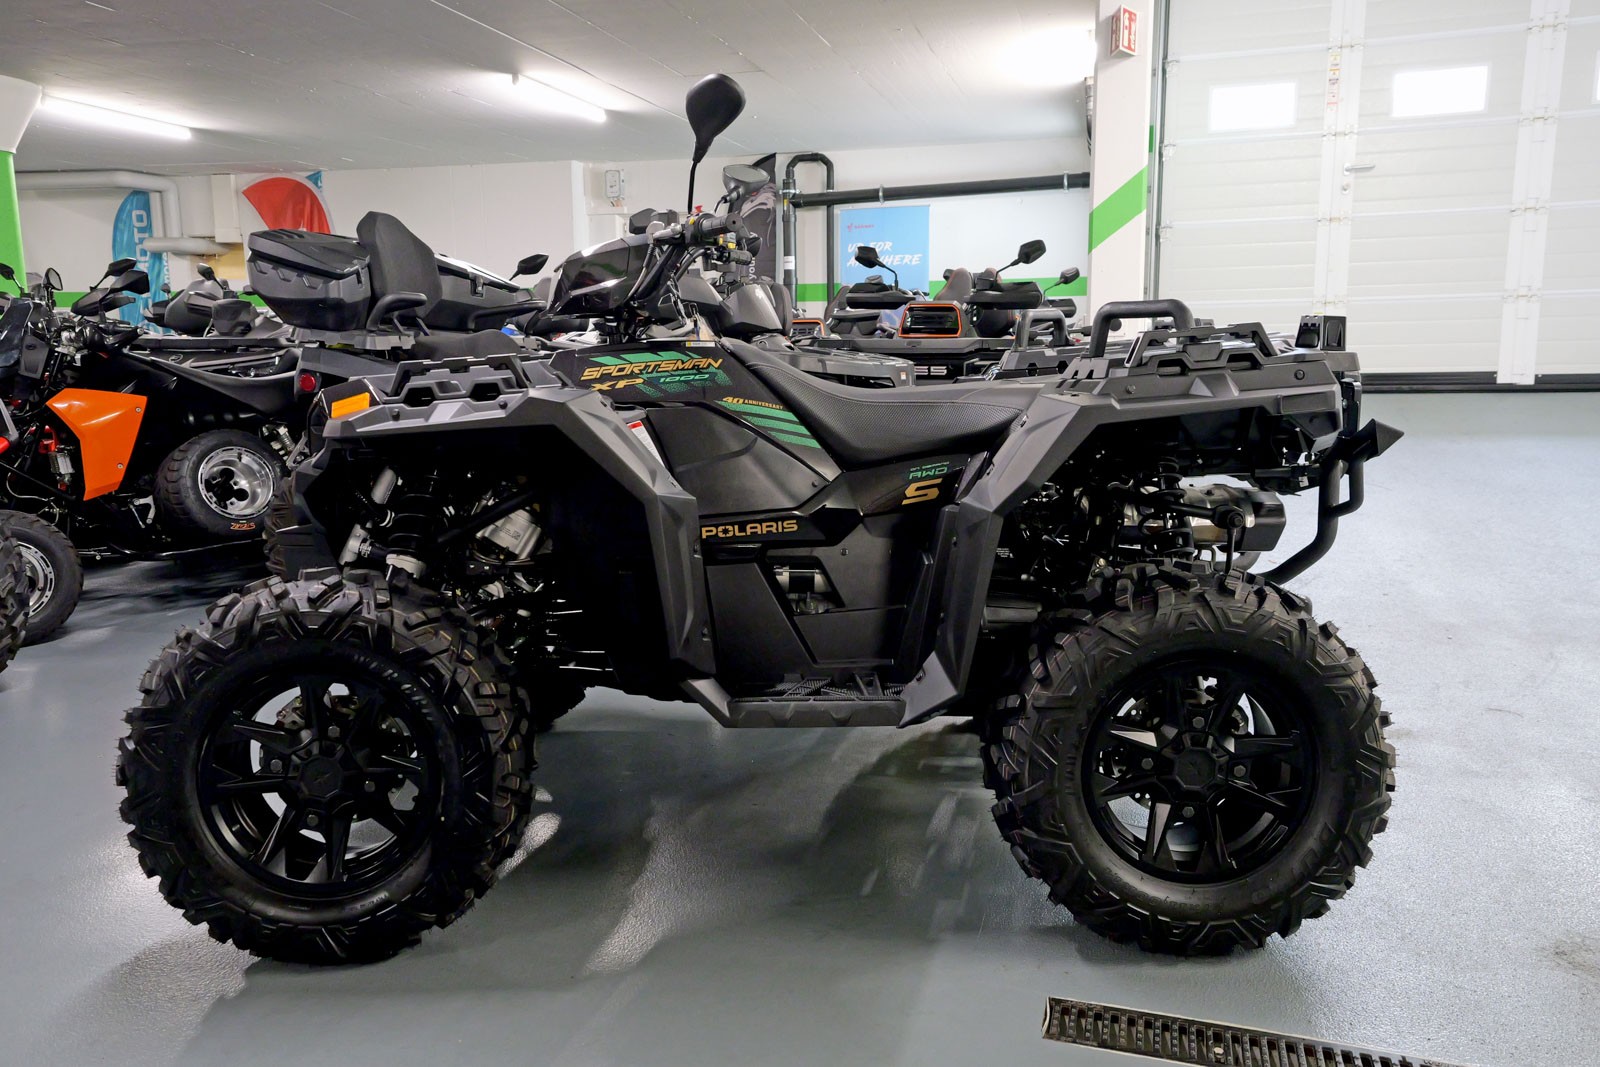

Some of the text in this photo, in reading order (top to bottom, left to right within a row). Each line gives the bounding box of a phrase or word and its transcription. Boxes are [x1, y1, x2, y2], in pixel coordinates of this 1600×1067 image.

[847, 254, 922, 267] AHERE
[580, 358, 723, 381] SPORTSMAN
[591, 374, 710, 391] XP 1000
[722, 396, 783, 410] 40 ANNIVERSARY
[909, 466, 947, 479] AWD
[901, 478, 943, 505] S
[701, 520, 798, 539] POLARIS
